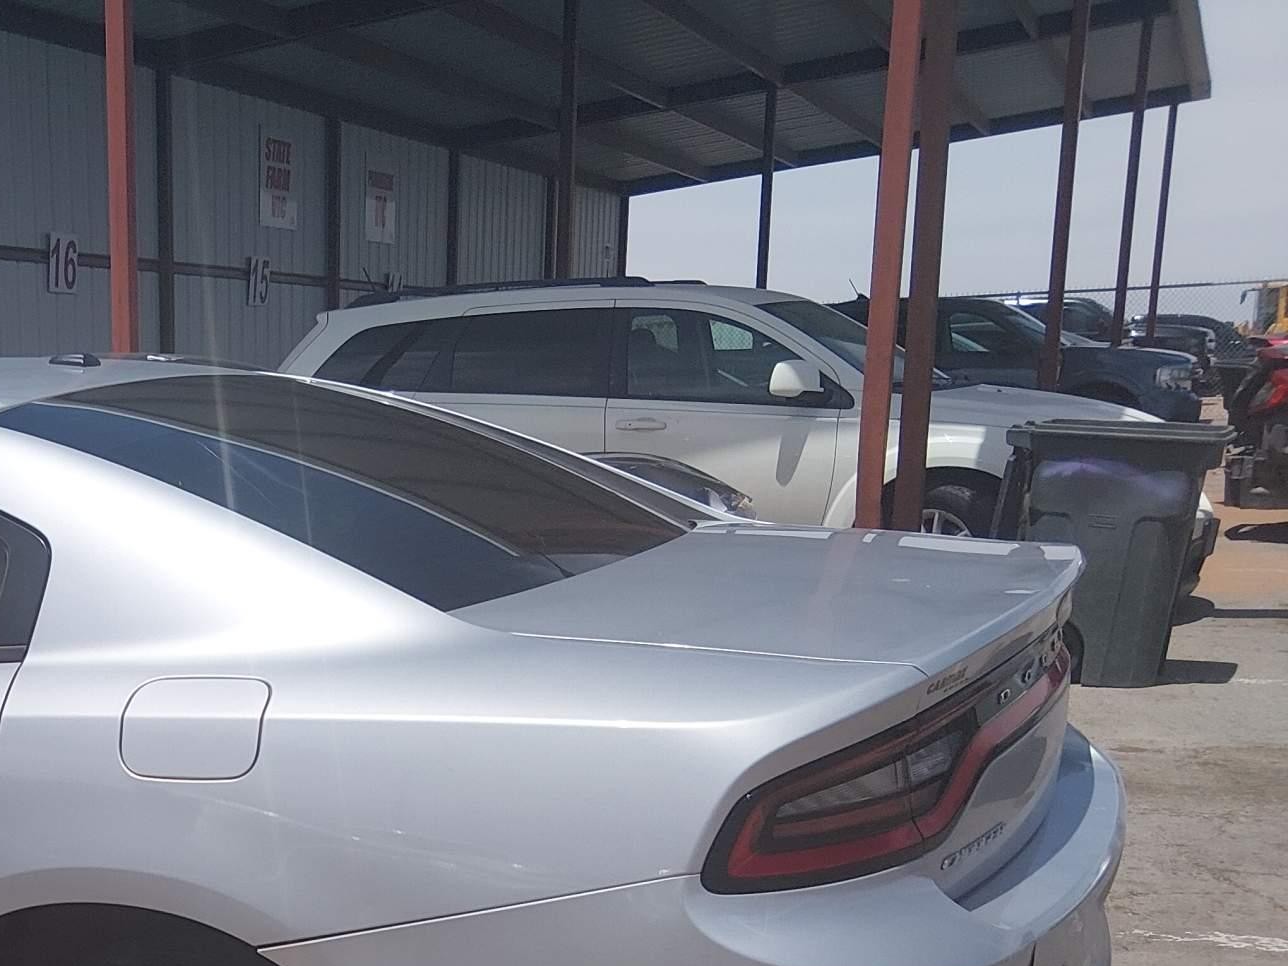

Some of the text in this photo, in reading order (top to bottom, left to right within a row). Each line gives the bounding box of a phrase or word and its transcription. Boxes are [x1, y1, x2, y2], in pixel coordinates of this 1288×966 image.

[265, 137, 292, 165] STATE
[51, 238, 77, 290] 16
[252, 259, 270, 304] 15
